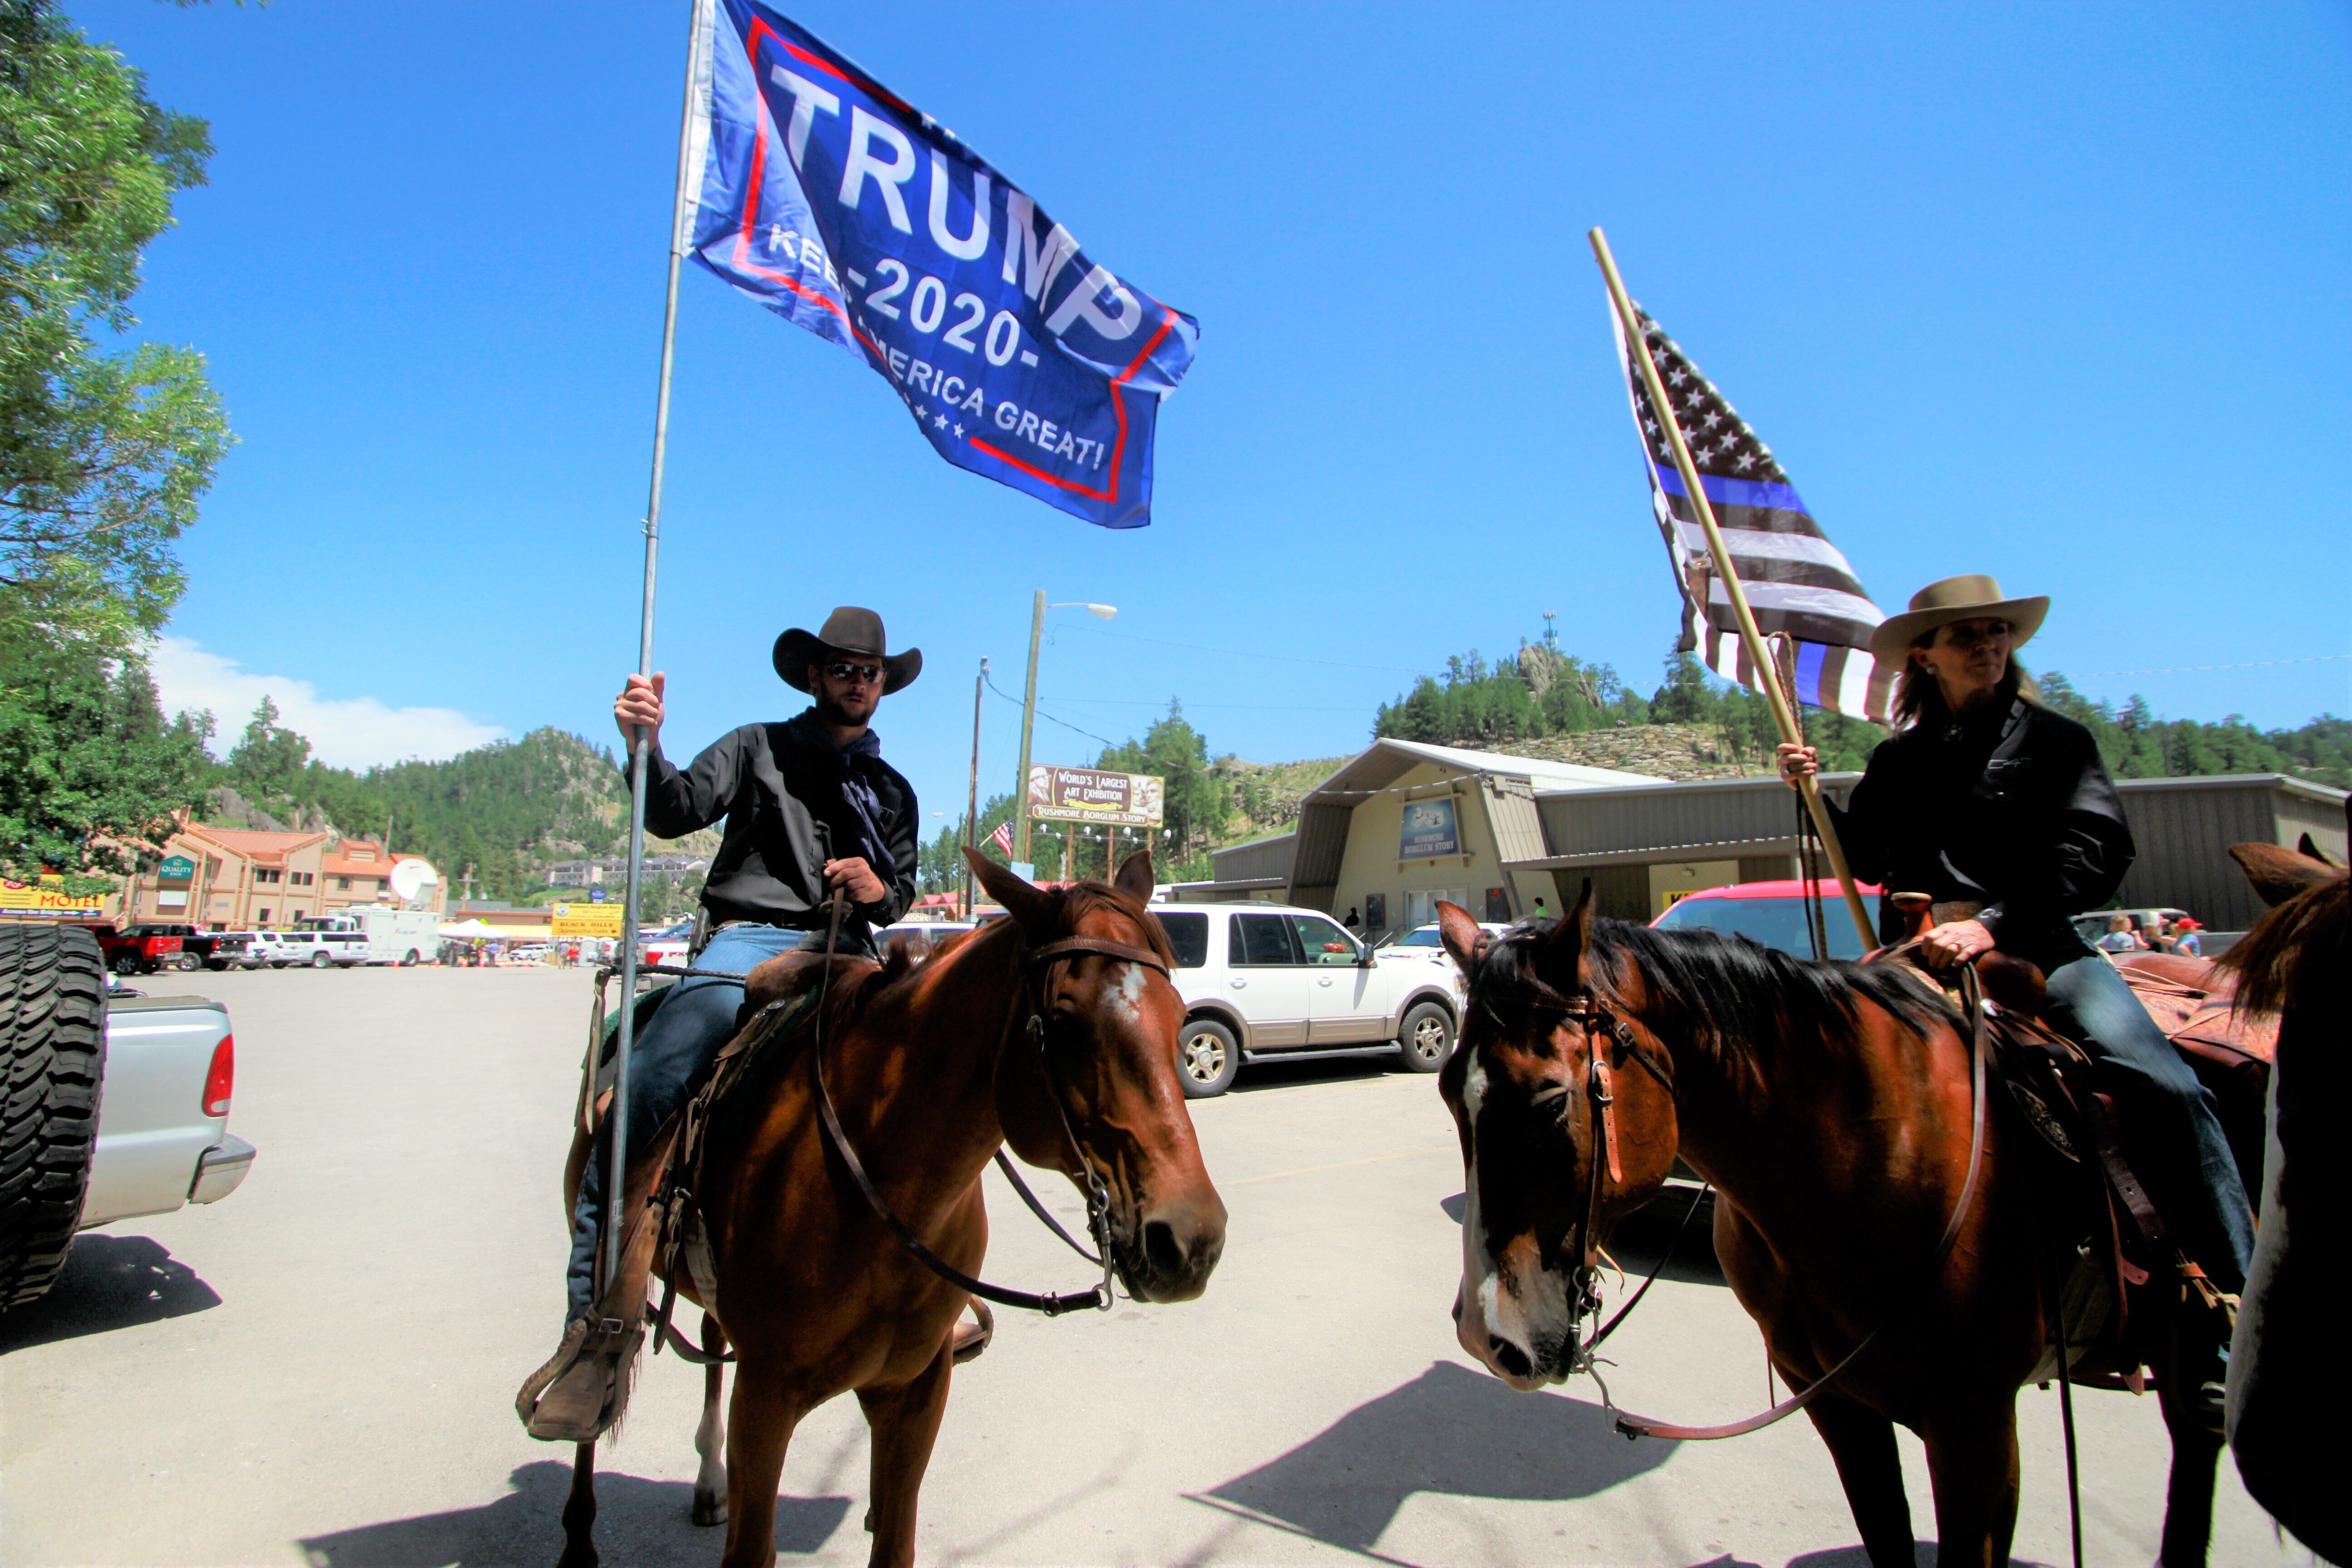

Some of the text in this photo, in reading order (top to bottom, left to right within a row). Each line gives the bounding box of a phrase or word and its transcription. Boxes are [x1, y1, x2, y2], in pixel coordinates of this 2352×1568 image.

[770, 65, 1142, 340] TRUMP
[769, 223, 852, 303] KEE
[847, 258, 1039, 368] -2020-
[994, 401, 1106, 471] GREAT!
[1058, 770, 1128, 789] WORLD'S LARGEST
[1063, 787, 1123, 801] ART EXHIBITION
[1037, 806, 1146, 823] RUSHMORE BORGLUM STORY
[1405, 841, 1454, 853] BORGLUM STORY
[1415, 833, 1444, 843] RUSHMORE
